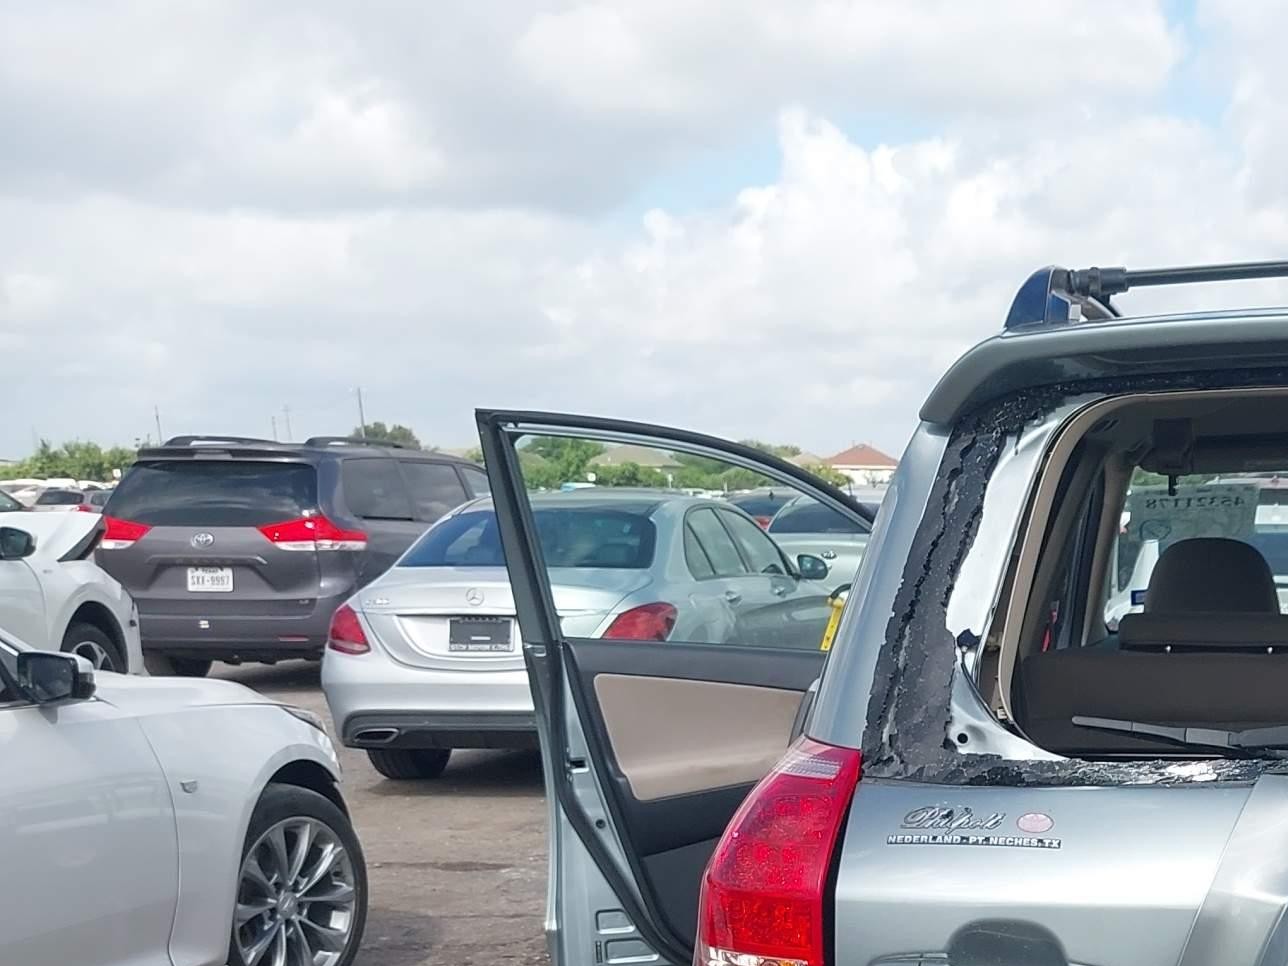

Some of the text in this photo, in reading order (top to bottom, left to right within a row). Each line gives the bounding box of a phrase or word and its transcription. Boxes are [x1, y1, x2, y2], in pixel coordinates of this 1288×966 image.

[887, 834, 962, 845] NEDERLAND
[969, 835, 988, 845] PT.
[989, 836, 1042, 847] NECHES,
[1043, 838, 1061, 849] TX
